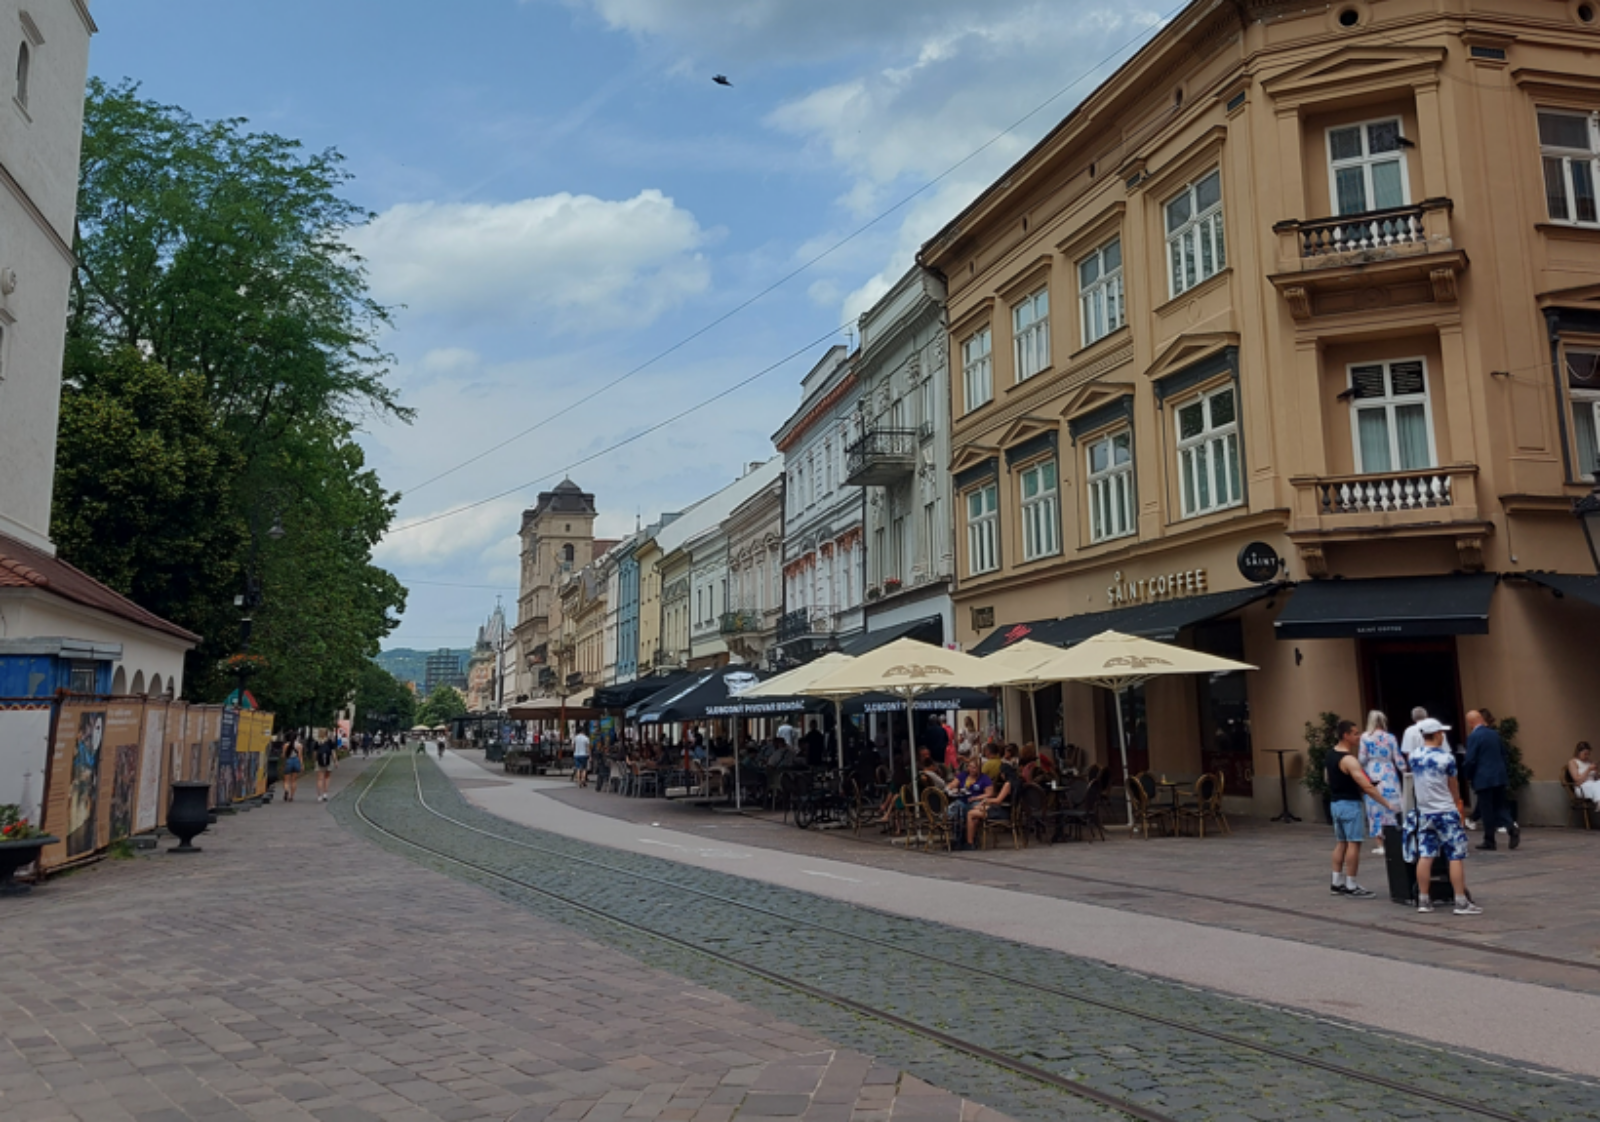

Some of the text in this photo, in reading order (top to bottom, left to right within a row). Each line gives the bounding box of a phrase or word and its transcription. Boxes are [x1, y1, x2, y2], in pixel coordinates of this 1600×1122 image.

[1246, 556, 1275, 566] SAINT
[1106, 569, 1208, 604] SAINT COFFEE
